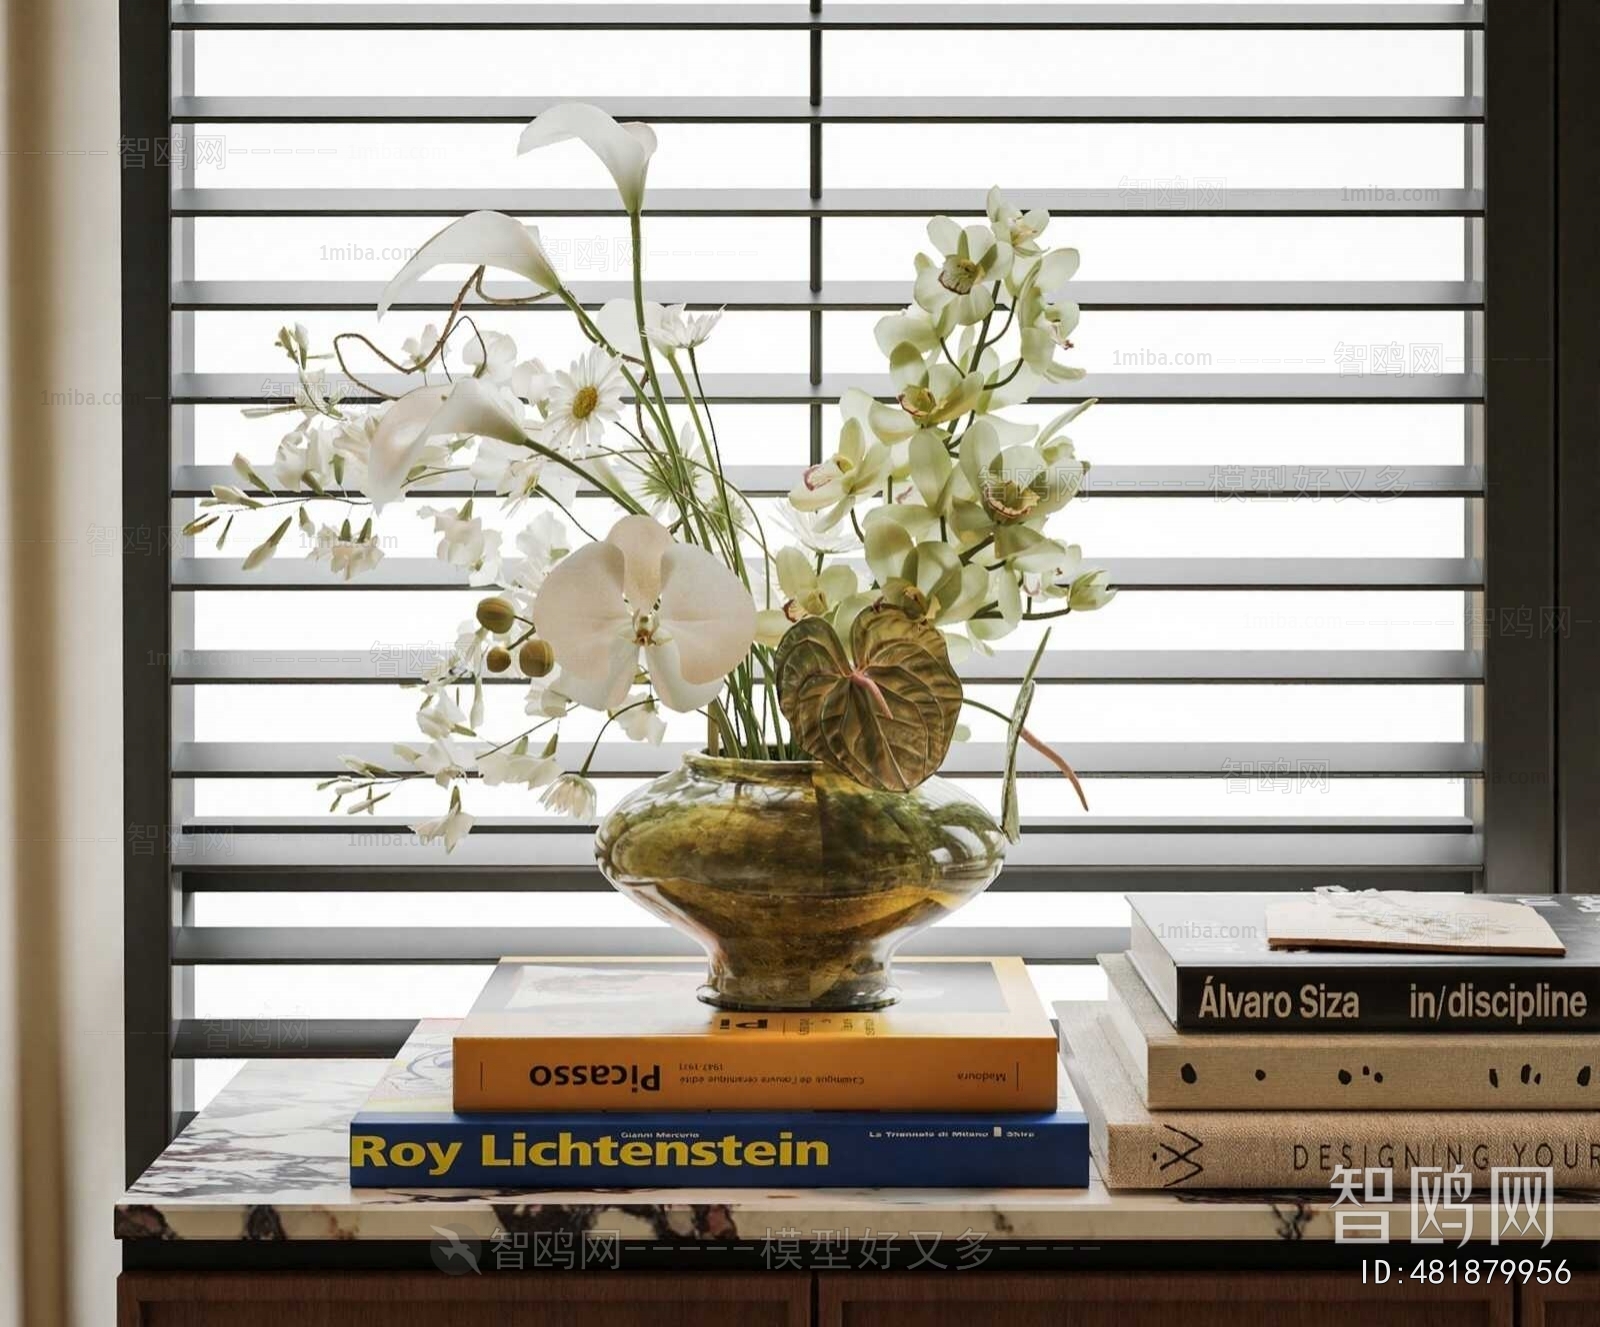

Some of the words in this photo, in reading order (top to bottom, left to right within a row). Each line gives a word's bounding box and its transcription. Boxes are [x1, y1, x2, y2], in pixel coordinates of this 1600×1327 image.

[1199, 975, 1292, 1019] Álvaro
[1299, 982, 1360, 1019] Siza
[1409, 982, 1588, 1025] in/discipline
[529, 1064, 661, 1093] Picasso
[957, 1070, 1007, 1083] Madoura
[351, 1135, 462, 1175] Roy
[482, 1132, 829, 1167] Lichtenstein
[1293, 1144, 1489, 1170] DESIGNING
[1513, 1143, 1600, 1169] YOUR
